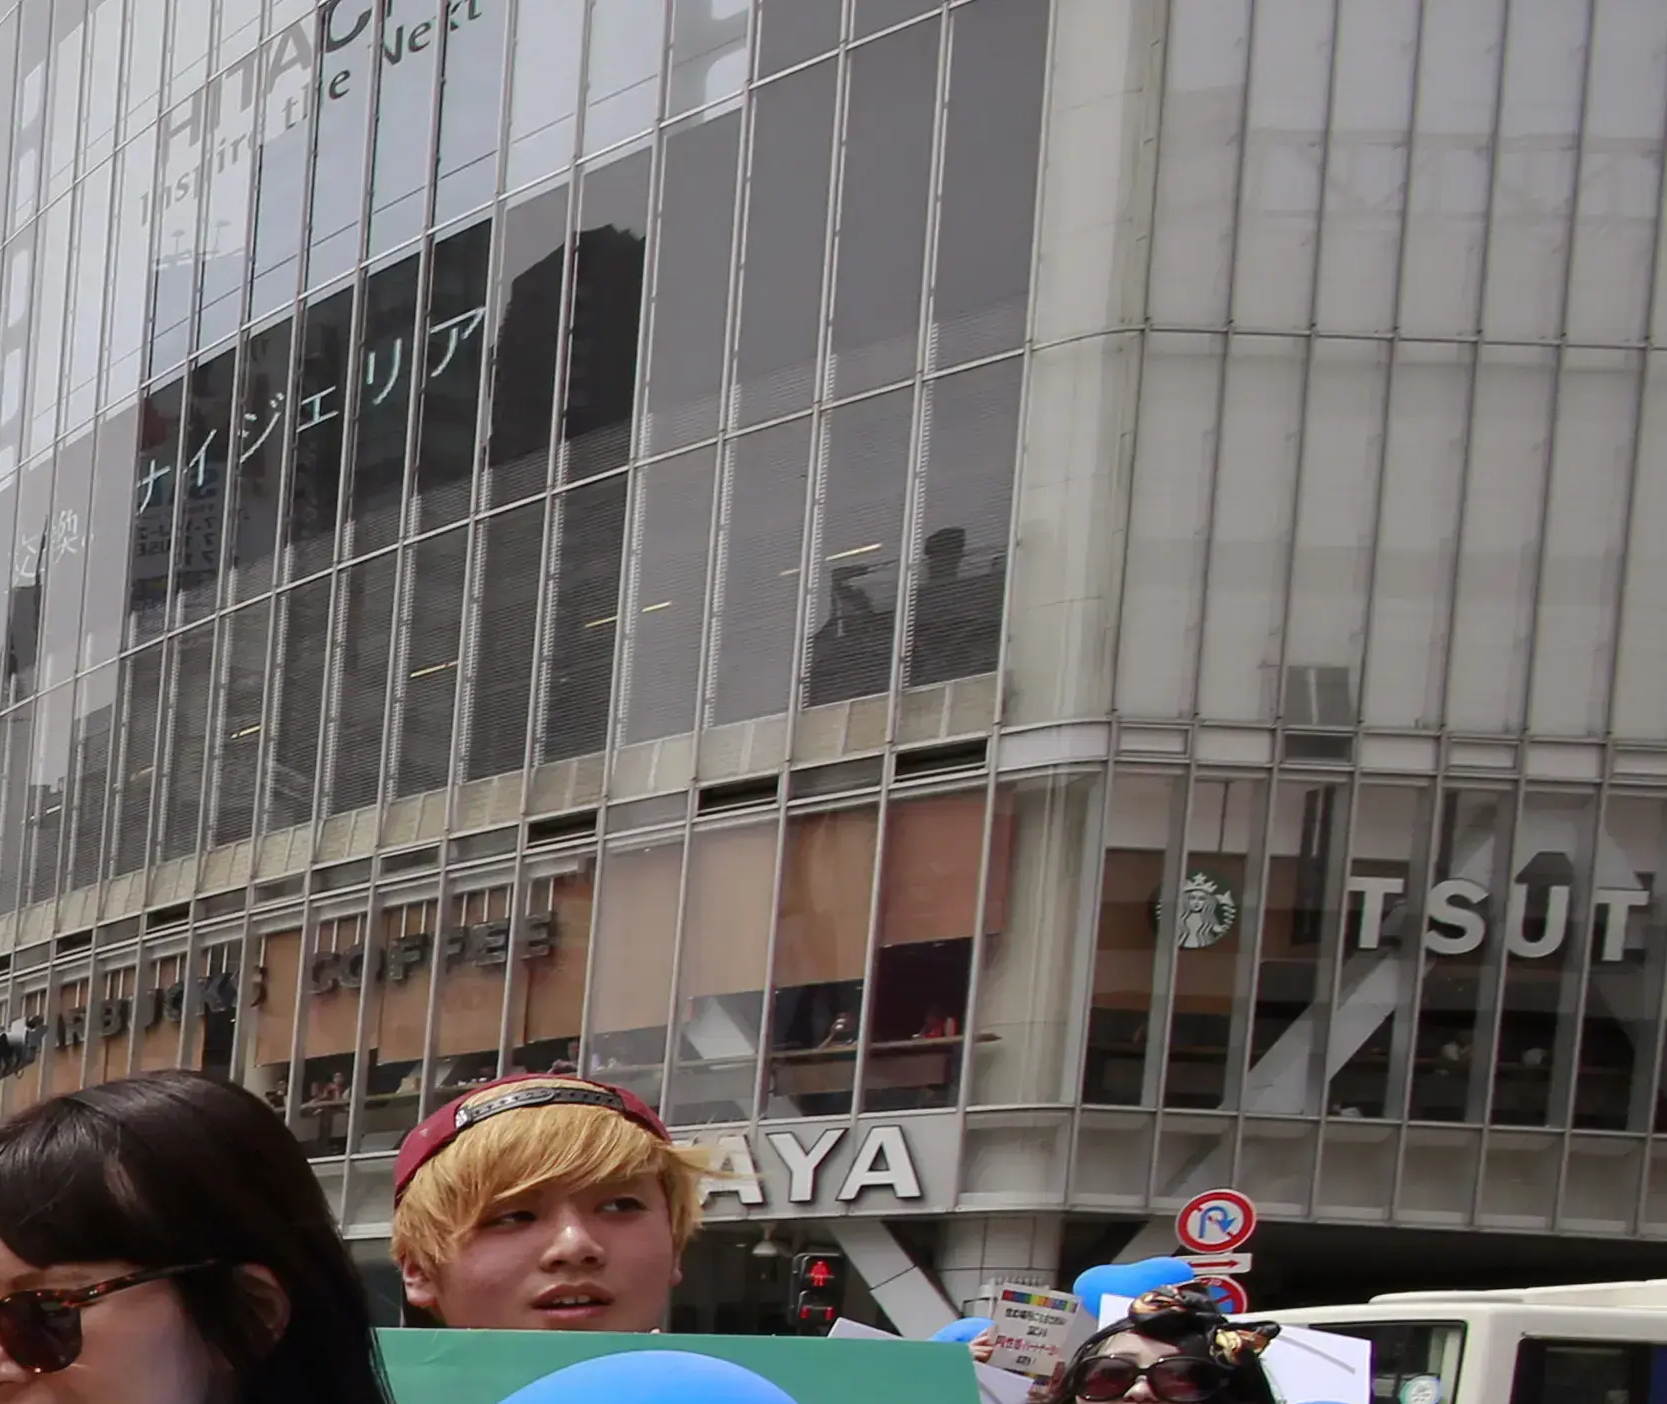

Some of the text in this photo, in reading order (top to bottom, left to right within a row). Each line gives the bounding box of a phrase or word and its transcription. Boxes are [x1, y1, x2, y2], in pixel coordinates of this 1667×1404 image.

[137, 306, 487, 516] ナイジェリア
[1349, 875, 1649, 963] TSUT
